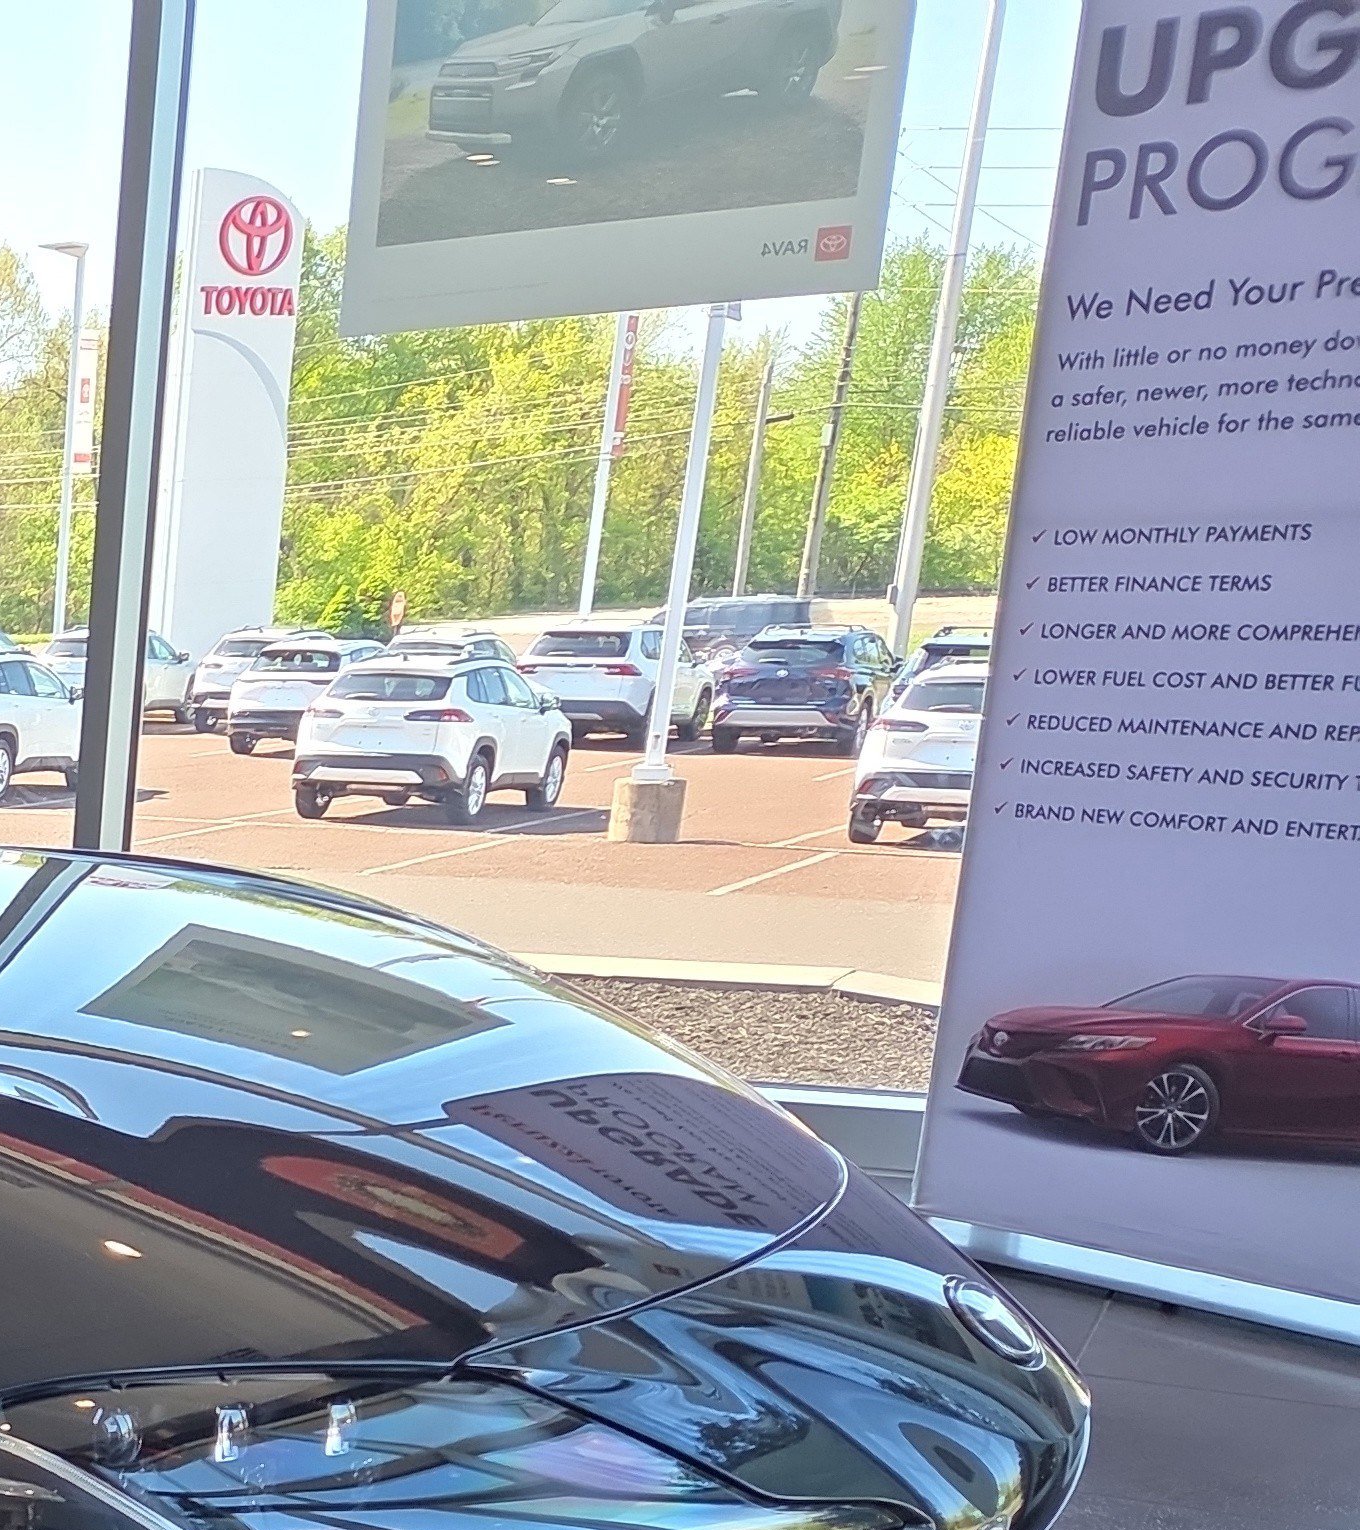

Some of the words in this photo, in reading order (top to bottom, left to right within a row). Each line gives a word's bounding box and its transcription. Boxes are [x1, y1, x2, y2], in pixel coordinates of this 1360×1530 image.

[1095, 0, 1360, 118] UPG
[200, 285, 295, 317] TOYOTA
[1066, 291, 1114, 322] We
[1125, 278, 1216, 317] Need
[1228, 276, 1306, 307] Your
[1314, 269, 1360, 299] Pre
[1057, 349, 1105, 371] With
[1112, 345, 1160, 368] little
[1166, 348, 1192, 364] or
[1197, 345, 1228, 362] no
[1235, 338, 1318, 359] money
[1322, 329, 1360, 353] do
[1050, 394, 1064, 408] a
[1070, 384, 1128, 408] safer,
[1135, 384, 1209, 402] newer,
[1217, 379, 1280, 397] more
[1045, 420, 1126, 444] reliable
[1133, 414, 1210, 438] vehicle
[1217, 412, 1251, 434] for
[1257, 409, 1295, 432] the
[1053, 528, 1099, 546] LOW
[1101, 526, 1201, 545] MONTHLY
[1205, 522, 1313, 543] PAYMENTS
[1047, 575, 1109, 593] BETTER
[1114, 574, 1203, 593] FINANCE
[1208, 574, 1273, 593] TERMS
[1040, 622, 1117, 640] LONGER
[1120, 623, 1167, 640] AND
[1170, 623, 1232, 642] MORE
[1033, 668, 1097, 687] LOWER
[1101, 670, 1146, 688] FUEL
[1152, 671, 1208, 689] COST
[1209, 672, 1259, 690] AND
[1264, 673, 1335, 692] BETTER
[1026, 714, 1113, 733] REDUCED
[1116, 717, 1265, 739] MAINTENANCE
[1267, 722, 1318, 741] AND
[1323, 724, 1360, 743] REP
[1020, 758, 1121, 780] INCREASED
[1125, 763, 1195, 784] SAFETY
[1196, 768, 1245, 786] AND
[1250, 770, 1350, 791] SECURITY
[1014, 802, 1076, 822] BRAND
[1080, 808, 1126, 825] NEW
[1129, 810, 1229, 833] COMFORT
[1230, 817, 1279, 836] AND
[1284, 820, 1360, 842] ENTERT
